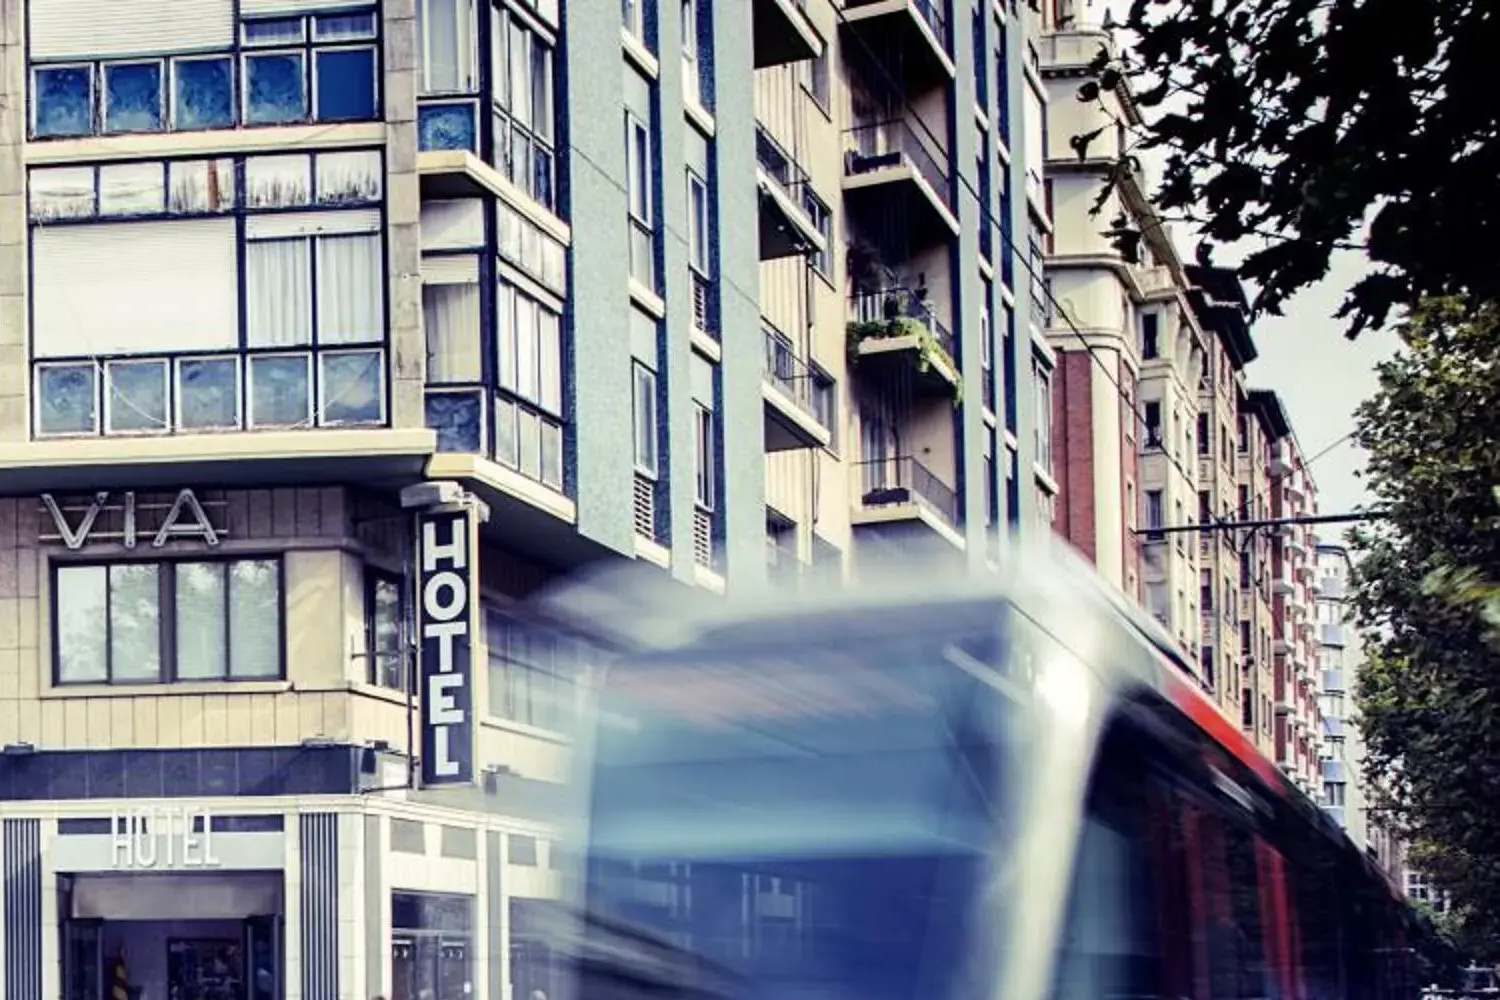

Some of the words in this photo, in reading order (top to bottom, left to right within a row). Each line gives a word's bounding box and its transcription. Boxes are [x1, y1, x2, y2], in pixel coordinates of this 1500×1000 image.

[41, 488, 219, 548] VIA
[423, 519, 467, 776] HOTEL
[112, 806, 221, 867] HOTEL
